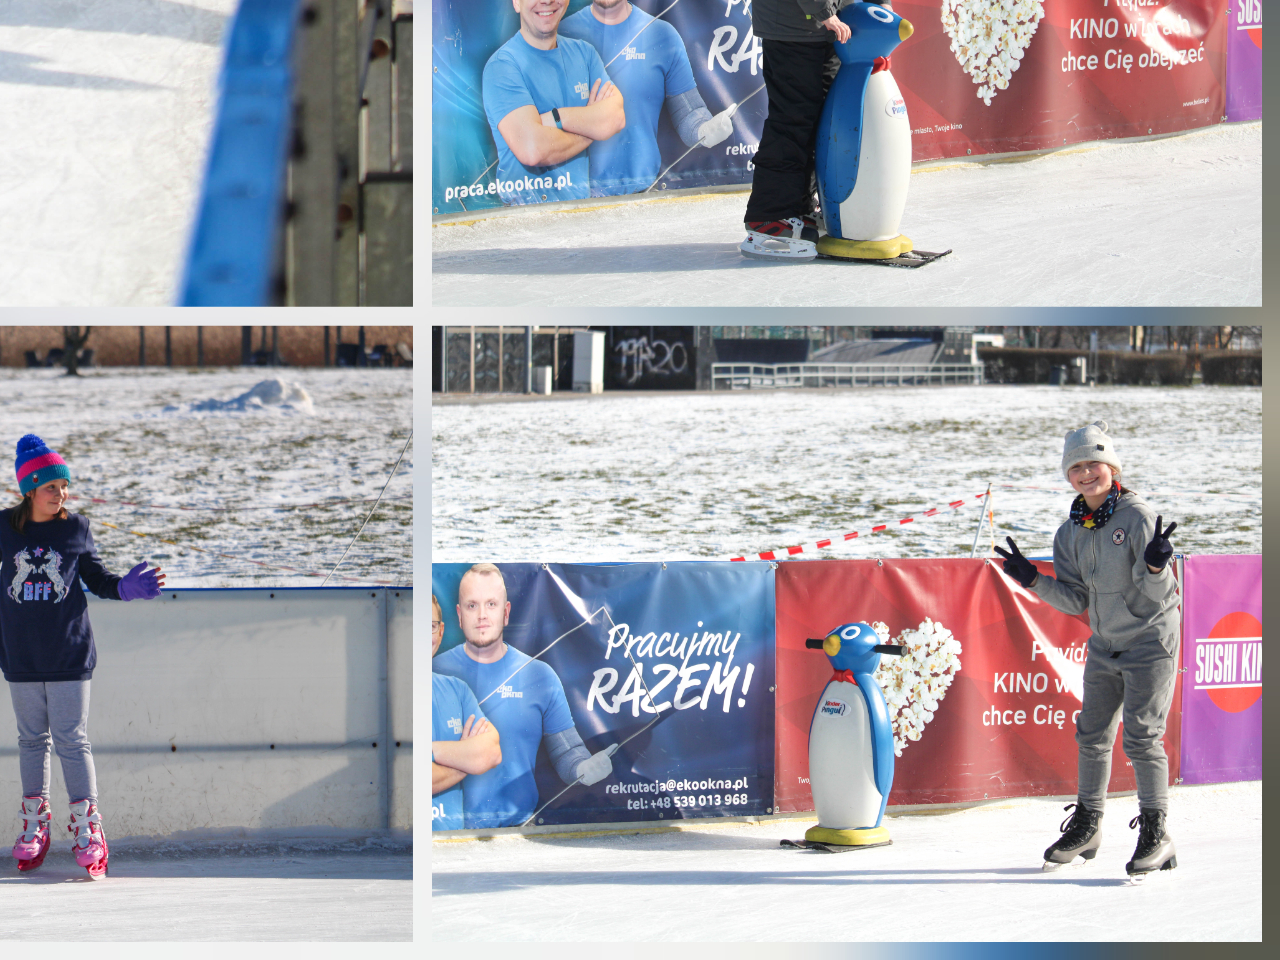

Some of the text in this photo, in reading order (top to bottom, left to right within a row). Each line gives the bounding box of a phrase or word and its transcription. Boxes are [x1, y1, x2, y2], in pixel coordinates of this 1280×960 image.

[1070, 18, 1119, 39] KINO
[1124, 22, 1137, 38] w
[1062, 51, 1098, 72] chce
[1104, 49, 1133, 73] Cię
[914, 127, 933, 135] miasto,
[445, 172, 572, 202] praca.ekookna.pl
[24, 582, 51, 600] BFF
[605, 621, 741, 677] Pracujmy
[1195, 644, 1238, 684] SUSHI
[586, 661, 755, 717] RAZEM!
[994, 672, 1048, 693] KINO
[983, 705, 1026, 726] chce
[1033, 704, 1066, 729] Cię
[606, 777, 748, 794] rekrutacja@ekookna.pl
[627, 794, 748, 810] tel: +48 539 013 968
